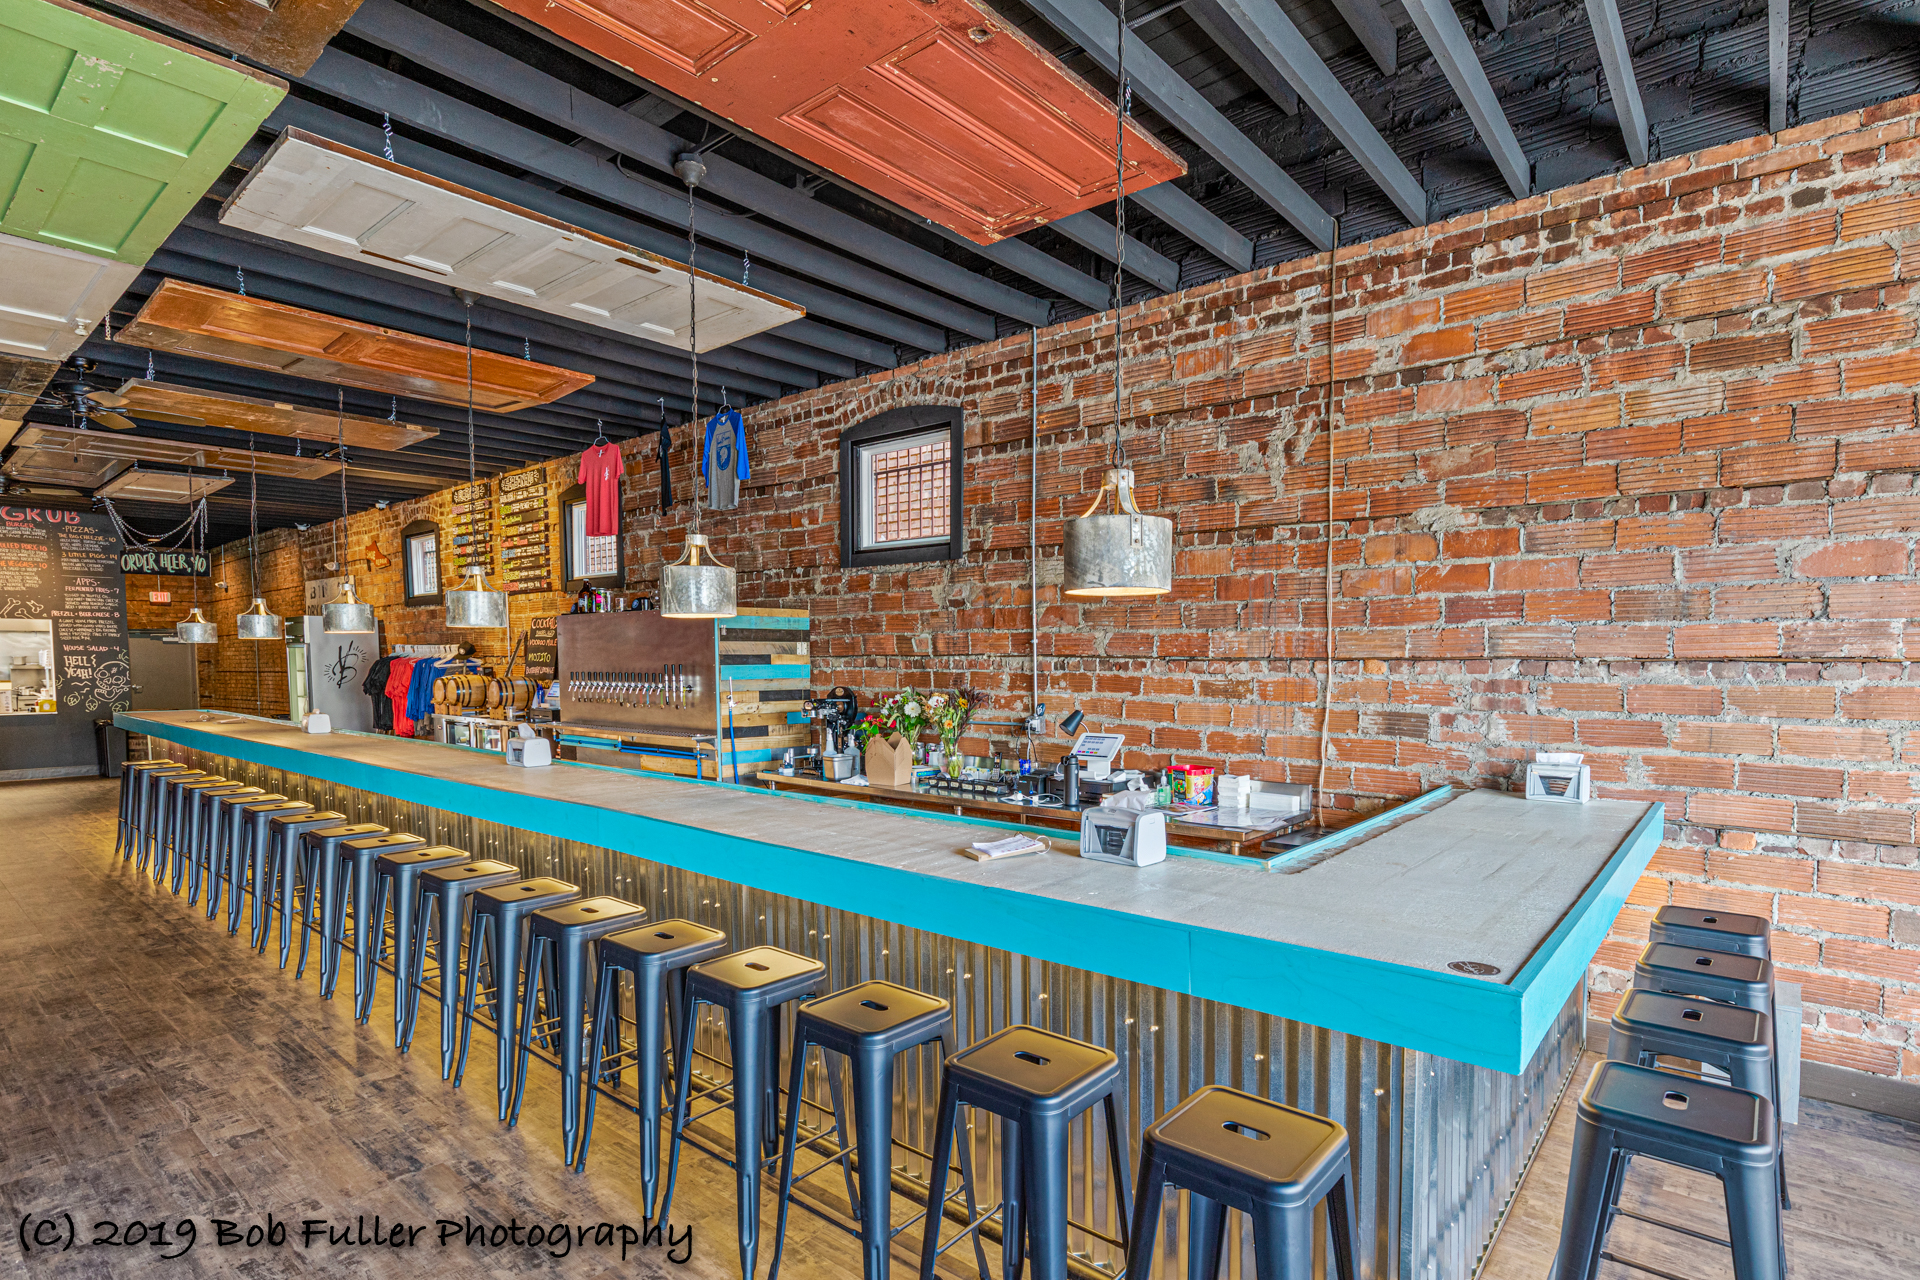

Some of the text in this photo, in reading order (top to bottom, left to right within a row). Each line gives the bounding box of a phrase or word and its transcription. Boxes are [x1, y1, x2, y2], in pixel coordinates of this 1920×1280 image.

[120, 552, 159, 573] ORDER
[191, 554, 207, 573] YO
[75, 577, 97, 587] APPS
[152, 592, 168, 603] EXIT
[63, 644, 85, 652] HOUSE
[63, 655, 91, 668] HELL
[528, 652, 551, 663] MOJITO
[64, 667, 93, 680] YEAH!
